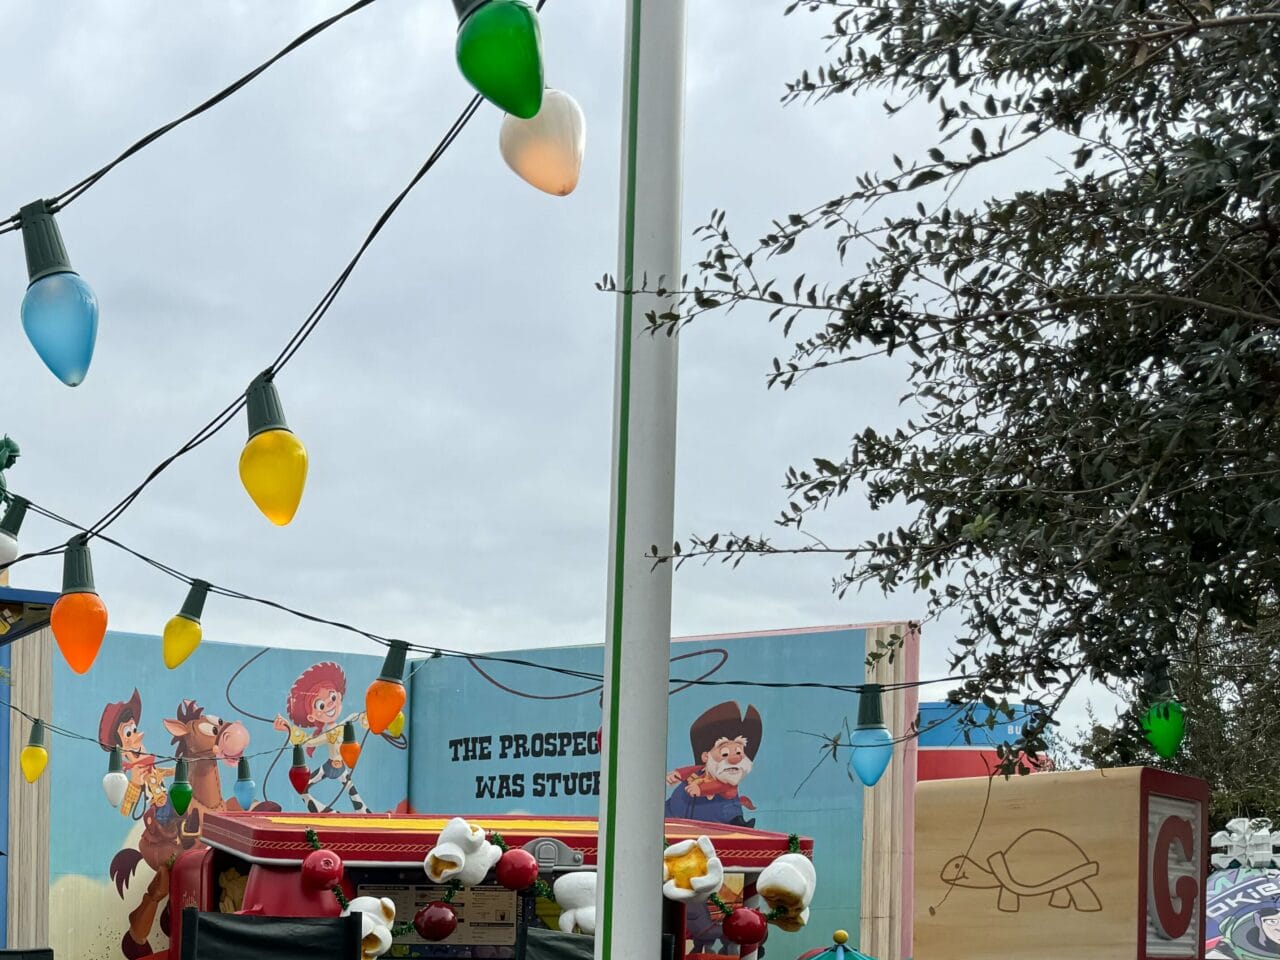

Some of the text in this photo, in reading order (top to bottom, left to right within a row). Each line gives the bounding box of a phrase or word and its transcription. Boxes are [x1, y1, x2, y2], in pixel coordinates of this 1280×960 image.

[1007, 724, 1021, 735] BU
[449, 731, 599, 761] THE PROSPEC
[475, 773, 525, 798] WAS
[1153, 815, 1198, 939] G
